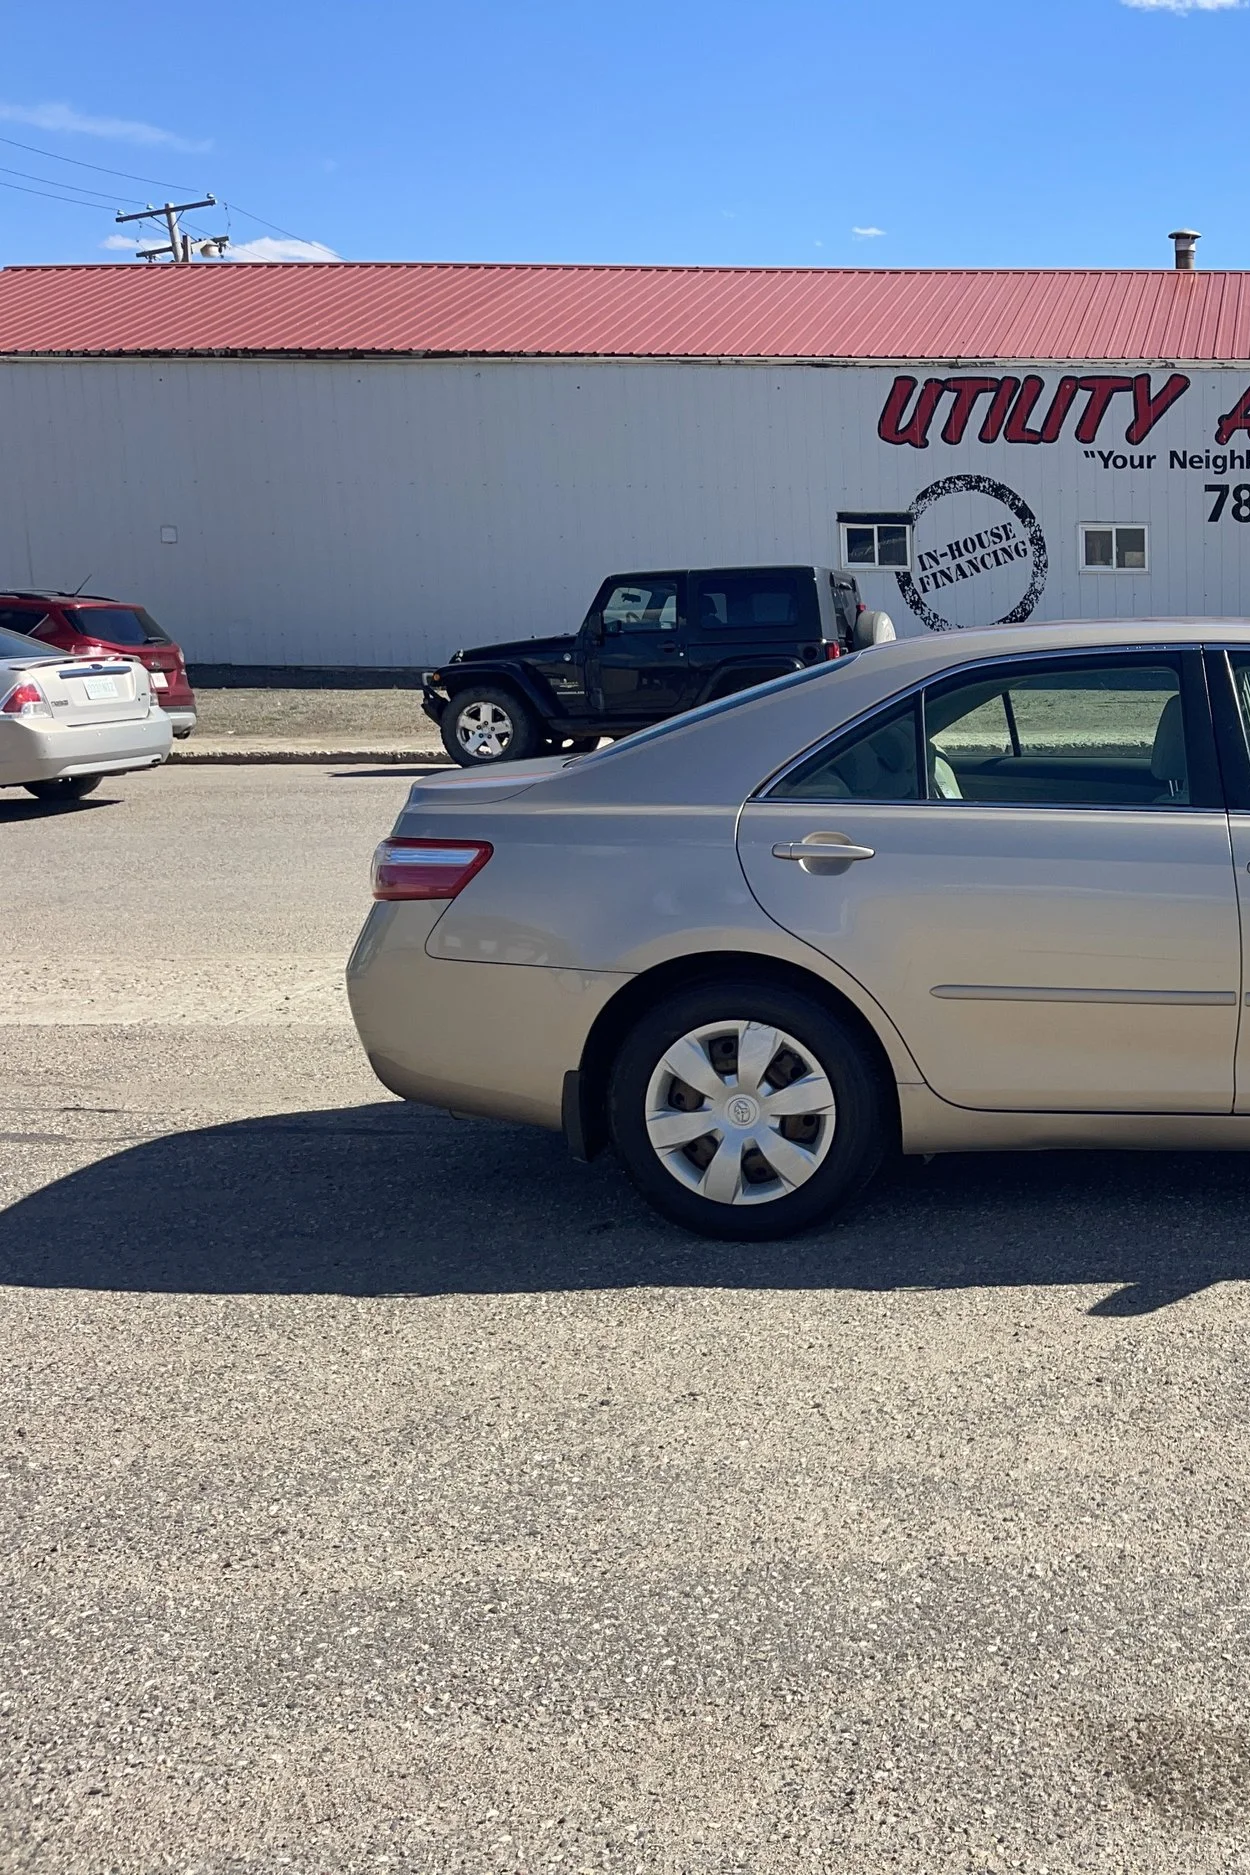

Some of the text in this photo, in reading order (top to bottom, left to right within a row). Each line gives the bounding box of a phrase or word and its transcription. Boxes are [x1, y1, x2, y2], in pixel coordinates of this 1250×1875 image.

[878, 373, 1191, 448] UTILITY
[917, 522, 1016, 572] IN-HOUSE
[918, 540, 1028, 594] FINANCING
